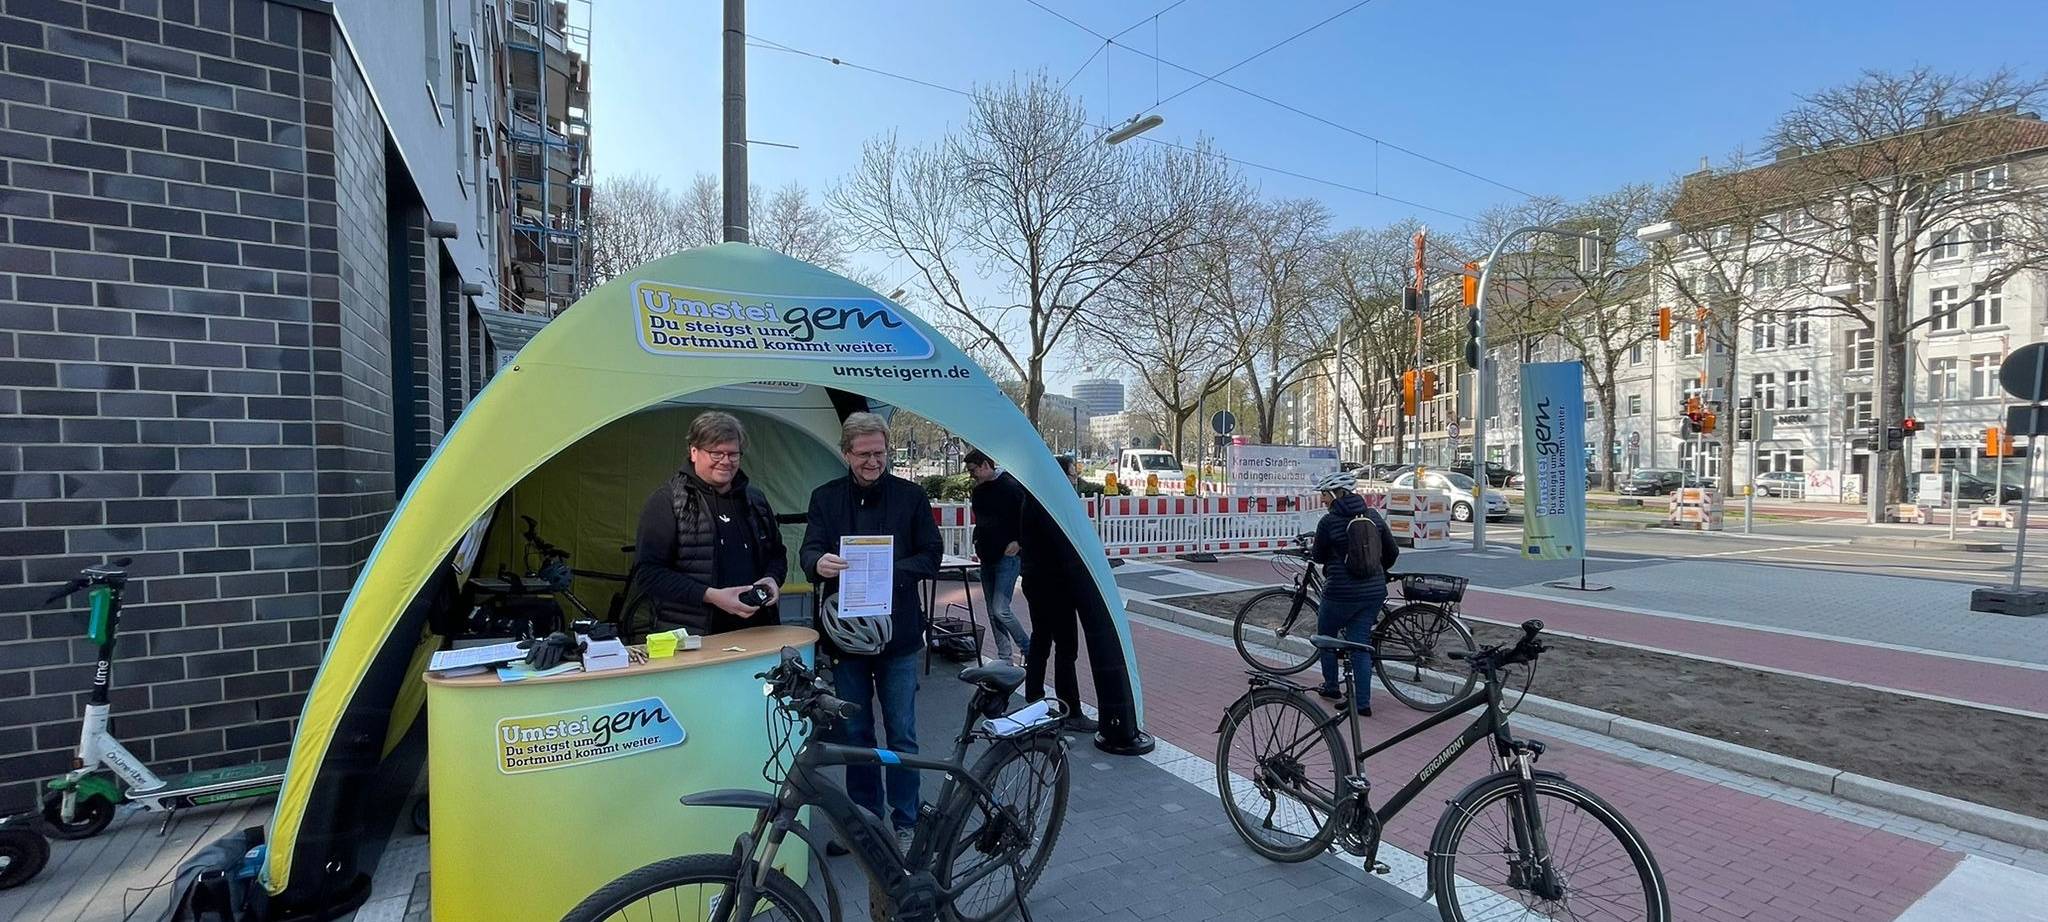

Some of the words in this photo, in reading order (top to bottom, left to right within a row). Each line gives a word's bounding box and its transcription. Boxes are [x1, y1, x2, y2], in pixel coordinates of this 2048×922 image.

[640, 288, 902, 342] Umsteigern
[650, 316, 680, 331] Du
[685, 320, 752, 337] steigst
[652, 331, 758, 350] Dortmund
[764, 338, 832, 352] kommt
[833, 341, 897, 353] weiter.
[833, 365, 970, 381] umsteigern.de
[1558, 403, 1566, 435] weiter.
[1265, 457, 1301, 467] Straßen-
[1535, 397, 1559, 518] Umsteigern
[1558, 436, 1566, 468] kommt
[1550, 471, 1558, 500] steigst
[1558, 470, 1566, 514] Dortmund
[1550, 503, 1557, 514] Du
[94, 659, 109, 686] Lime
[501, 707, 669, 747] Umsteigern
[506, 746, 523, 757] Du
[527, 740, 570, 755] steigst
[506, 752, 572, 768] Dortmund
[575, 743, 619, 759] kommt
[622, 735, 662, 750] weiter.
